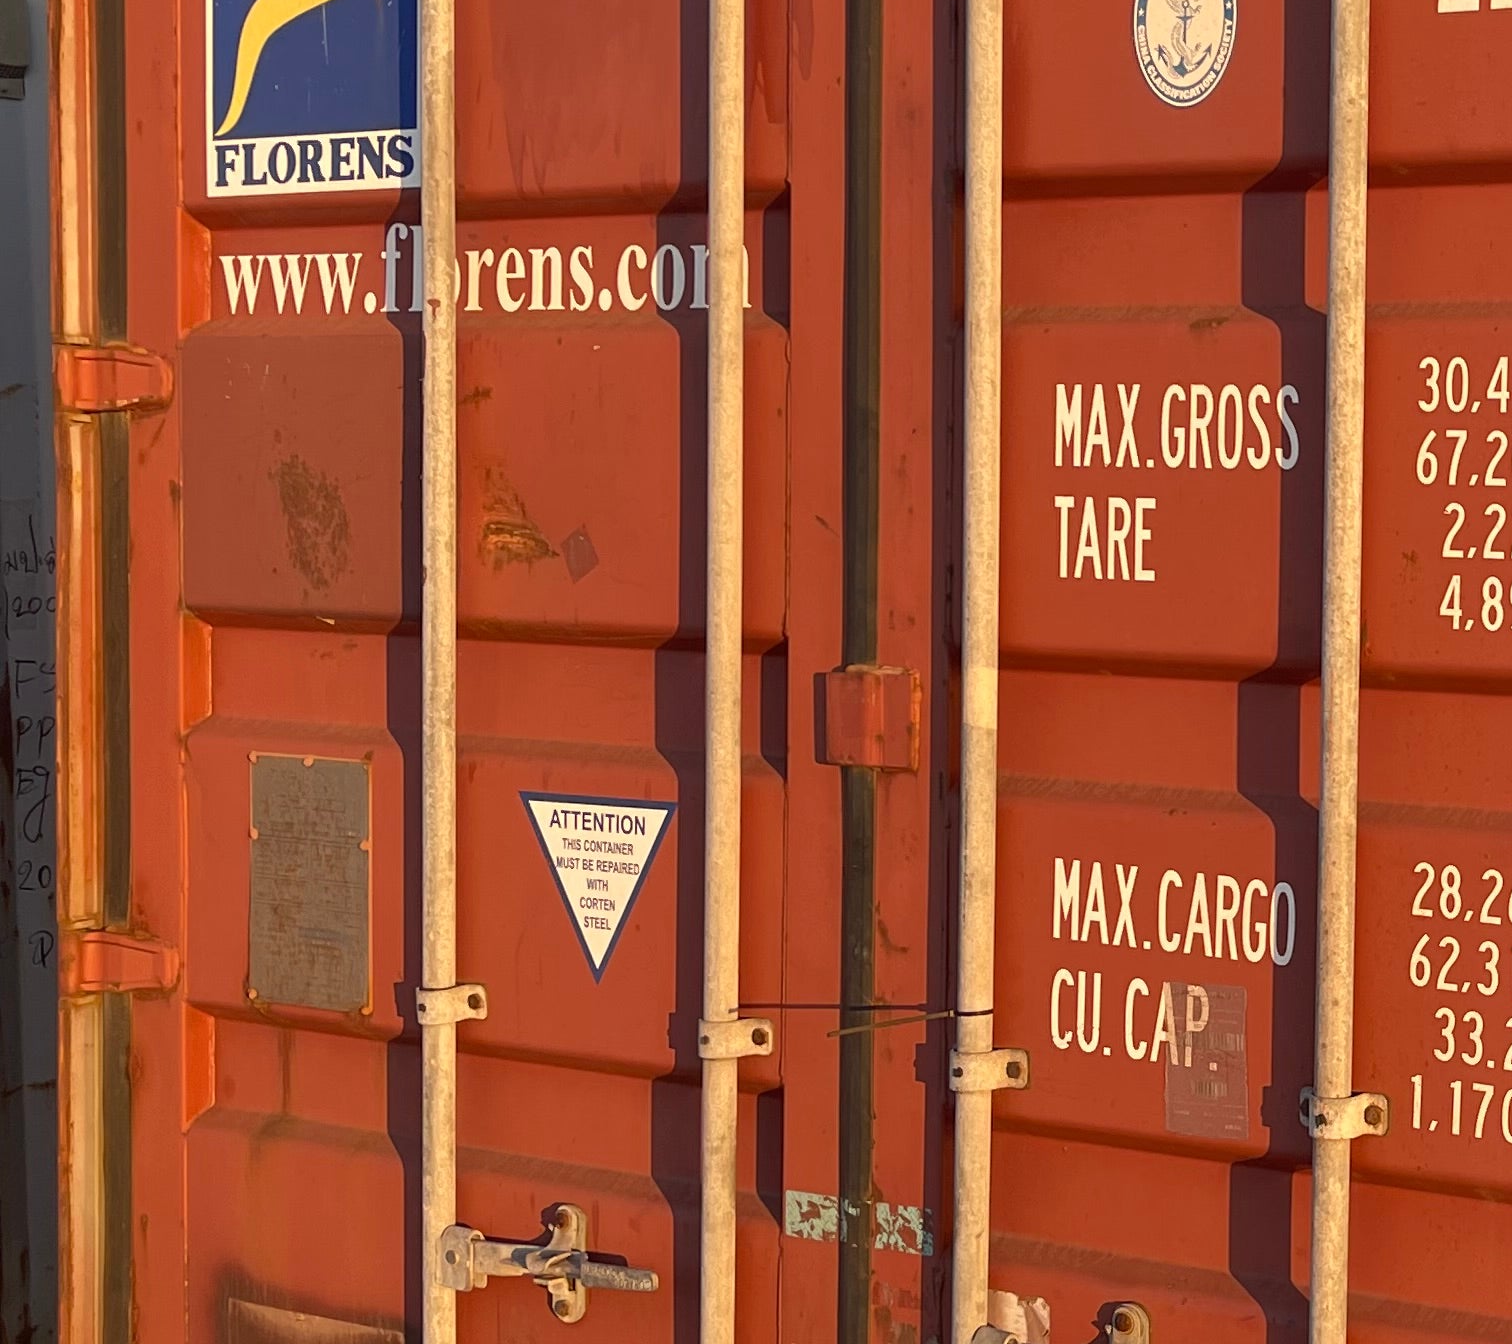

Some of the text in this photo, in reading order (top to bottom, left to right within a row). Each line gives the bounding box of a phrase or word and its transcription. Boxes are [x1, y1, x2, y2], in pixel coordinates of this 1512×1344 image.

[213, 134, 415, 188] FLORENS
[219, 221, 753, 314] www.flrens.co
[1054, 383, 1300, 470] MAX.GROSS
[1054, 495, 1157, 582] TARE
[549, 808, 646, 836] ATTENTION
[562, 837, 634, 856] THIS CONTAINER
[556, 856, 640, 876] MUST BE REPAIRED
[586, 878, 609, 892] WITH
[579, 896, 616, 912] CORTEN
[1052, 857, 1296, 966] MAX.CARGO
[583, 915, 611, 931] STEEL
